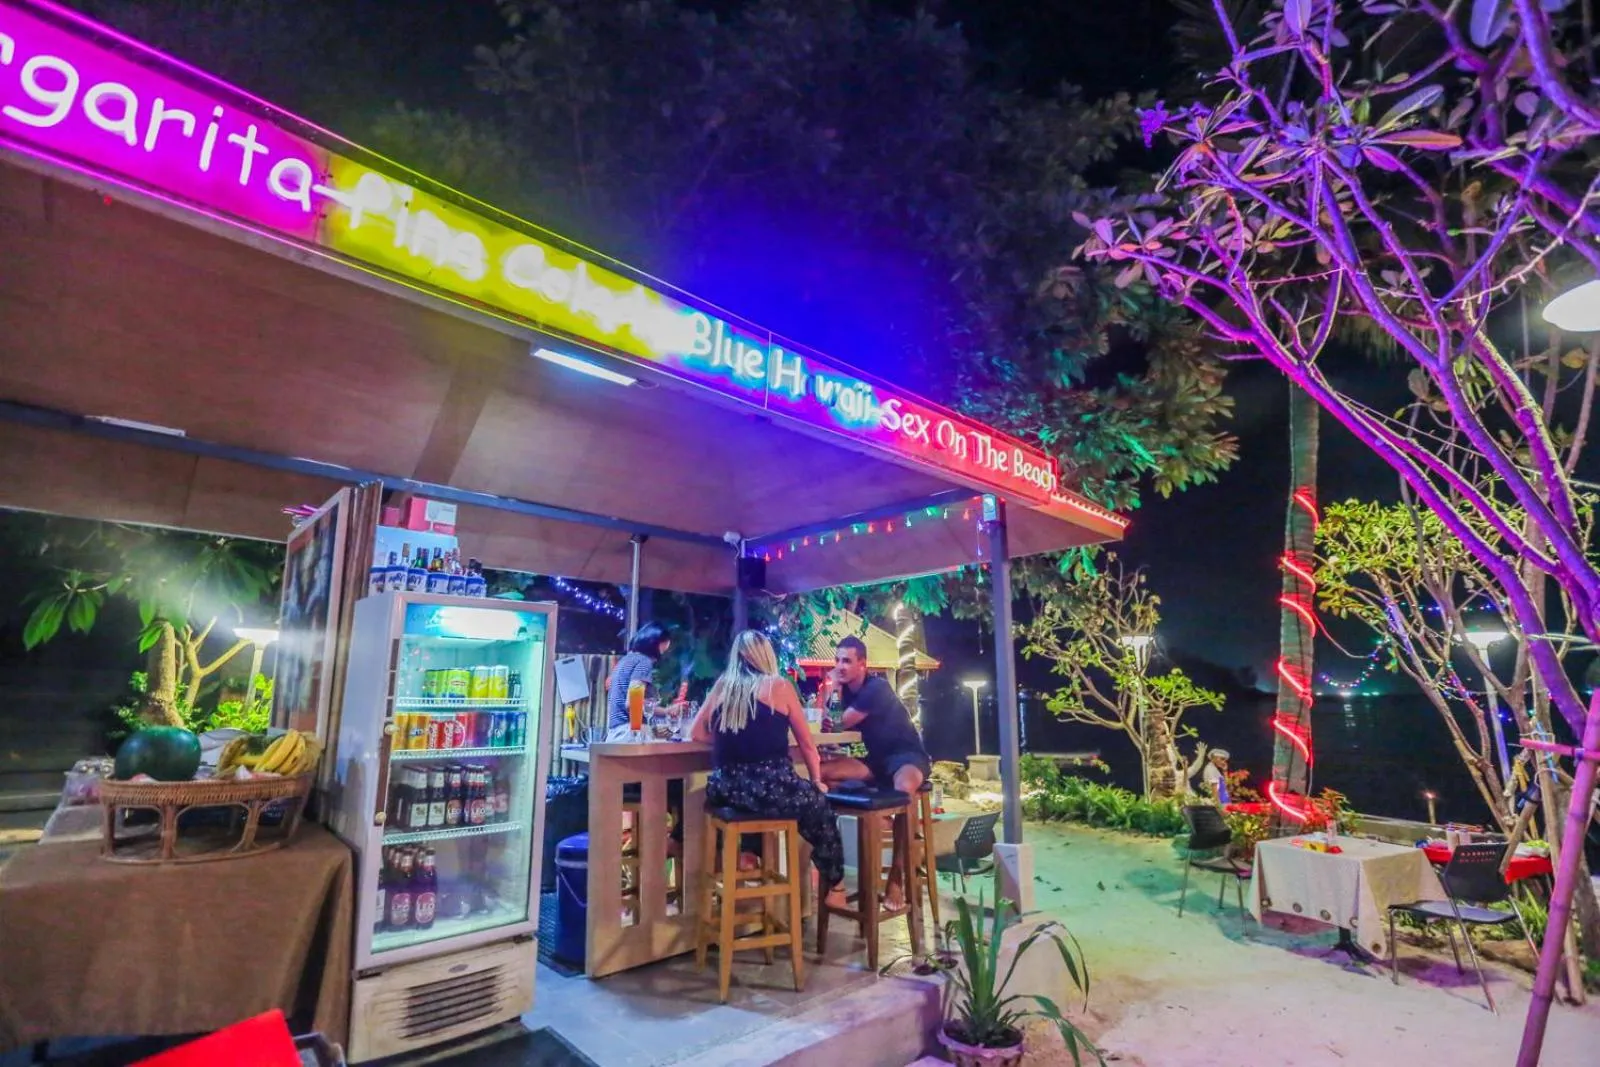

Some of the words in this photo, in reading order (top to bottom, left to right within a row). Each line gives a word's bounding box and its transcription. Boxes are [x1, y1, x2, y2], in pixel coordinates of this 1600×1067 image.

[690, 312, 765, 379] Blue
[880, 399, 930, 444] Sex
[937, 420, 967, 459] On
[969, 431, 1009, 472] The
[1013, 448, 1056, 491] Beach
